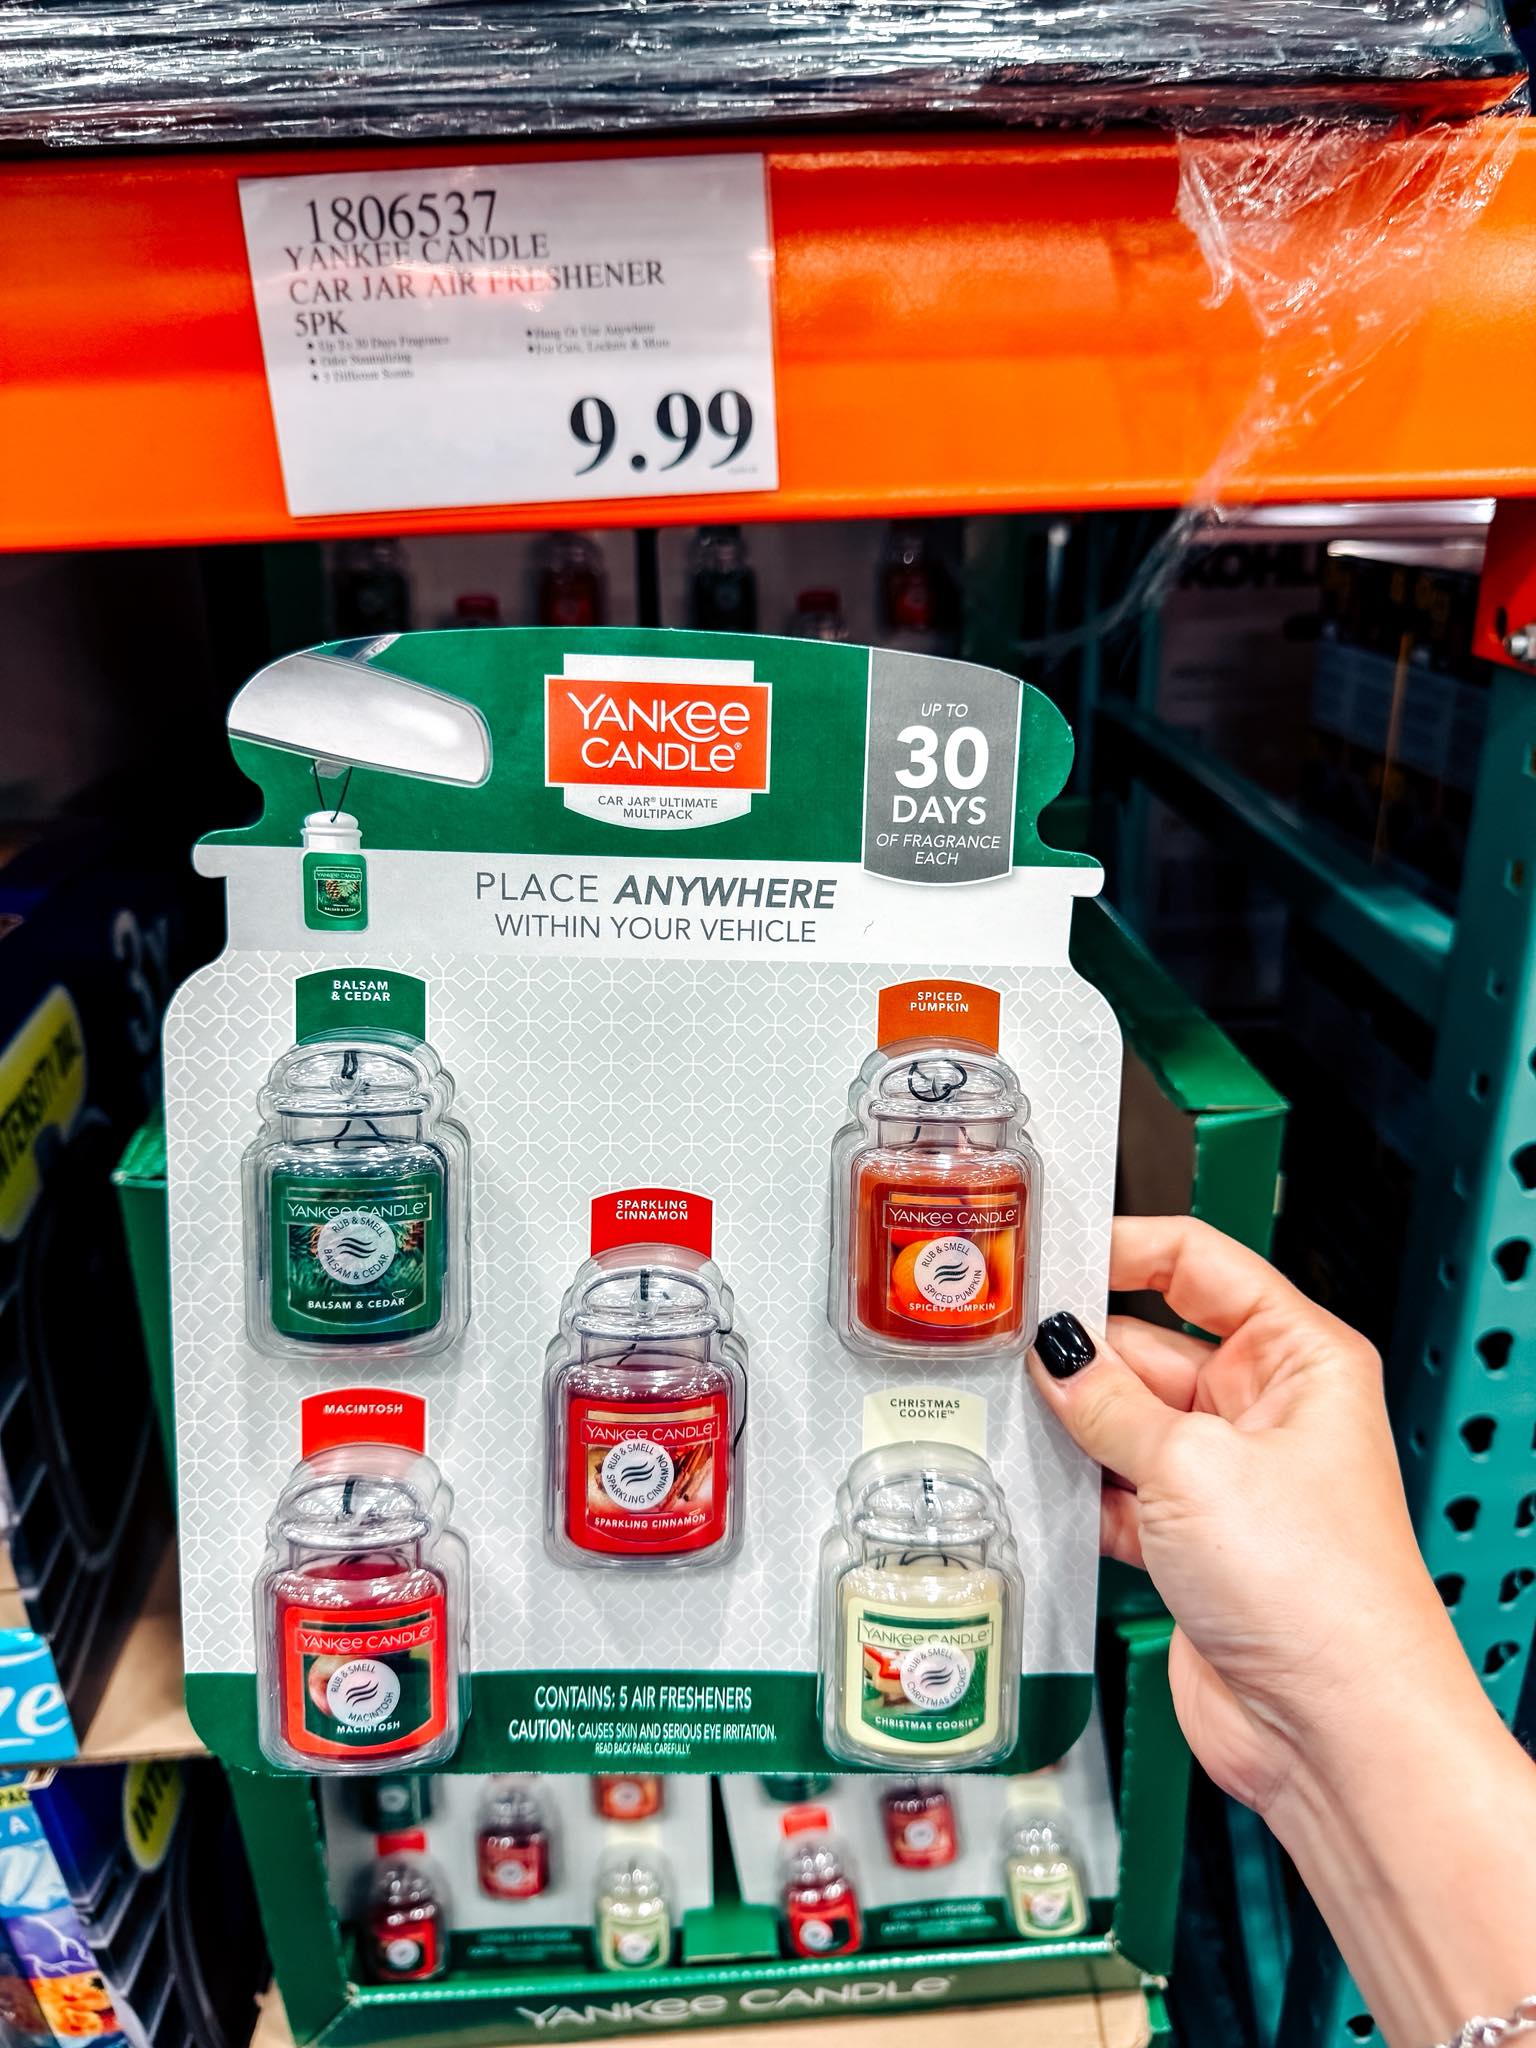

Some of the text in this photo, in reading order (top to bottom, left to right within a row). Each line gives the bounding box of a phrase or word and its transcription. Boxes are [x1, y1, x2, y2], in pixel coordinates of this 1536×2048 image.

[307, 190, 496, 243] 1806537
[284, 233, 549, 270] YANKEE CANDLE
[290, 260, 664, 304] CAR JAR AIR FRESHENER
[295, 311, 348, 337] 5PK
[570, 390, 753, 476] 9.99
[921, 703, 969, 718] UP TO
[895, 725, 989, 790] 30
[598, 796, 623, 806] CAR
[660, 797, 718, 808] ULTIMATE
[892, 795, 987, 825] DAYS
[623, 808, 693, 820] MULTIPACK
[876, 833, 1001, 849] OF FRAGRANCE
[914, 852, 958, 865] EACH
[476, 872, 838, 910] PLACE ANYWHERE
[494, 913, 816, 943] WITHIN YOUR VEHICLE
[331, 991, 390, 1001] & CEDAR
[333, 980, 389, 991] BALSAM
[917, 991, 963, 1002] SPICED
[910, 1002, 969, 1013] PUMPKIN
[615, 1211, 688, 1220] CINNAMON
[617, 1200, 687, 1210] SPARKLING
[331, 1216, 387, 1238] RUB & SMELL
[324, 1248, 390, 1280] BALSAM & CEDAR
[921, 1242, 971, 1268] RUB & SMELL
[924, 1269, 982, 1304] SPICED PUMPKIN
[307, 1298, 405, 1309] BALSAM & CEDAR
[909, 1302, 946, 1312] SPICED
[323, 1404, 403, 1415] MACINTOSH
[890, 1398, 960, 1409] CHRISTMAS
[607, 1443, 655, 1470] RUB & SMELL
[606, 1454, 669, 1504] SPARKLING CINNAMON
[594, 1513, 706, 1529] SPARKLING CINNAMON
[907, 1648, 954, 1673] RUB & SMELL
[331, 1663, 376, 1693] RUB & SMELL
[907, 1664, 967, 1706] CHRISTMAS COOKIE
[348, 1691, 394, 1722] MACINTOSH
[535, 1685, 752, 1710] CONTAINS: 5 AIR FRESHENERS
[336, 1721, 400, 1735] MACINTOSH
[509, 1719, 777, 1741] CAUTION: CAUSES SKIN AND SERIOUS EYE IRRITATION.
[875, 1716, 932, 1730] CHRISTMAS
[595, 1743, 691, 1755] READ BACK PANEL CAREFULLY.
